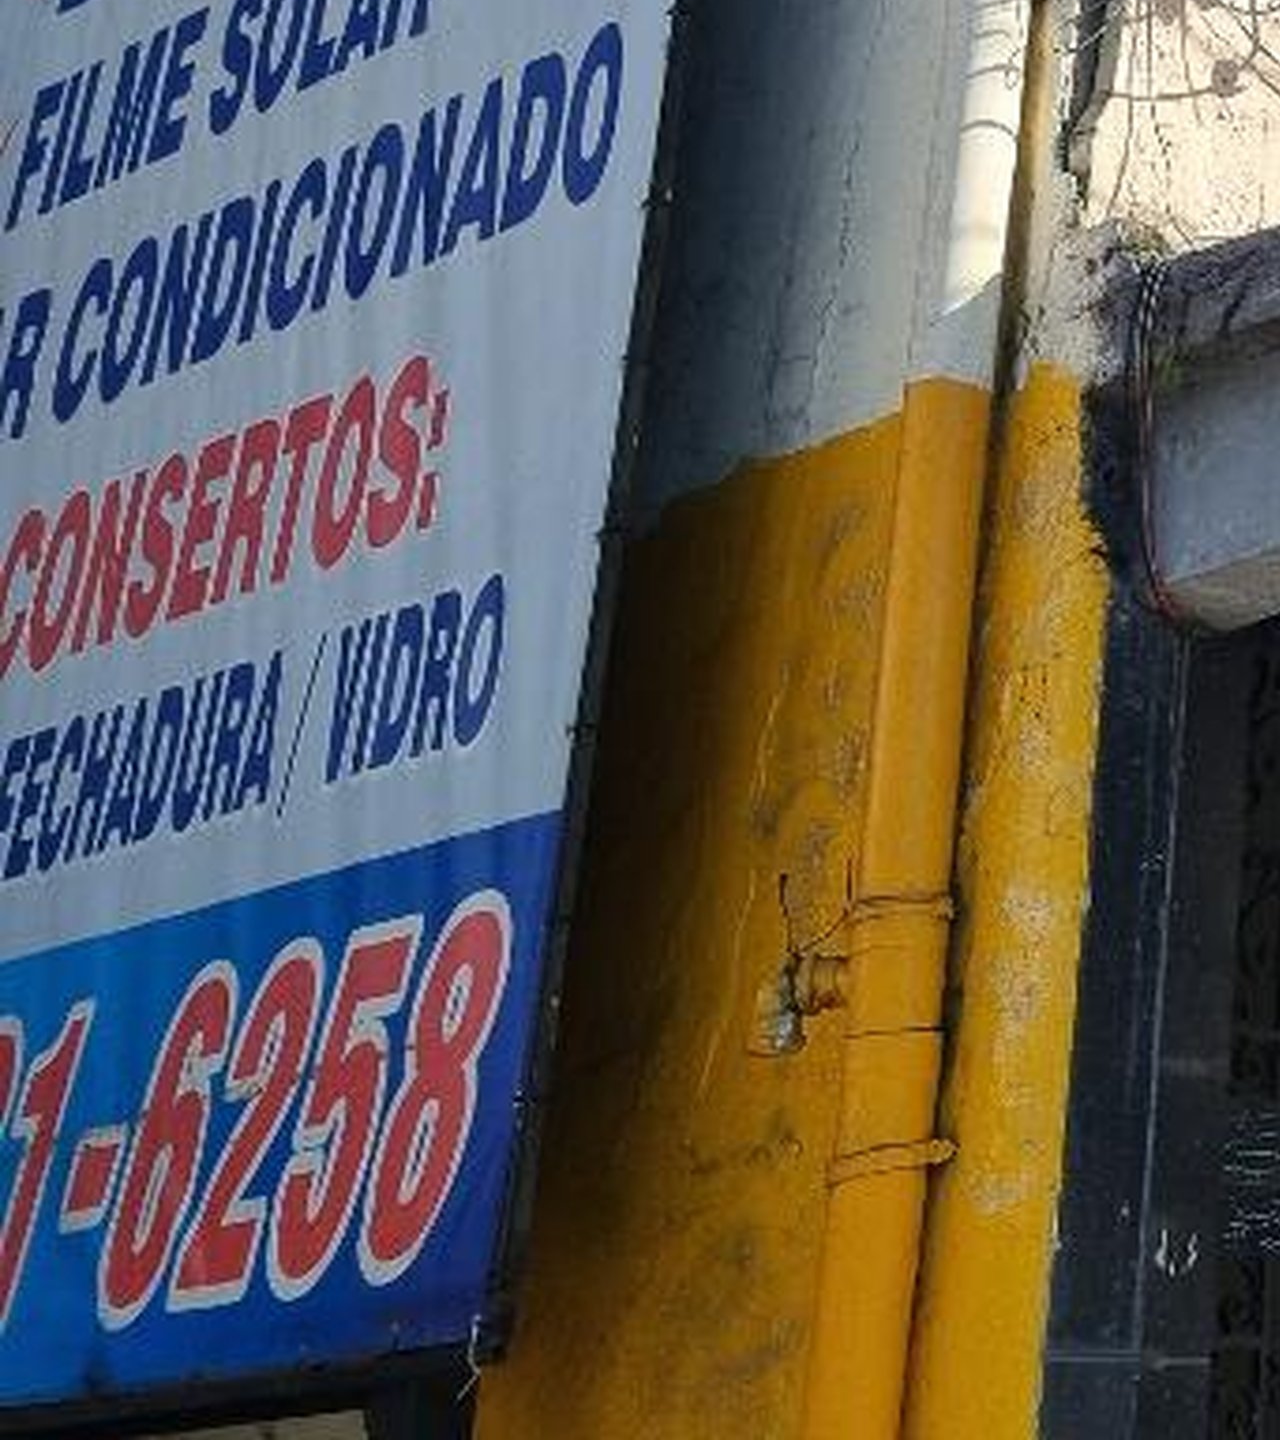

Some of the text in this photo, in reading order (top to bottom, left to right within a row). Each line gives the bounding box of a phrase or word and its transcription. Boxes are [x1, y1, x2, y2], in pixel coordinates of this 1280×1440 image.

[0, 22, 624, 439] R CONDICIONADO
[4, 6, 210, 232] FILME
[325, 572, 505, 784] VIDRO
[0, 888, 513, 1334] 1-6258
